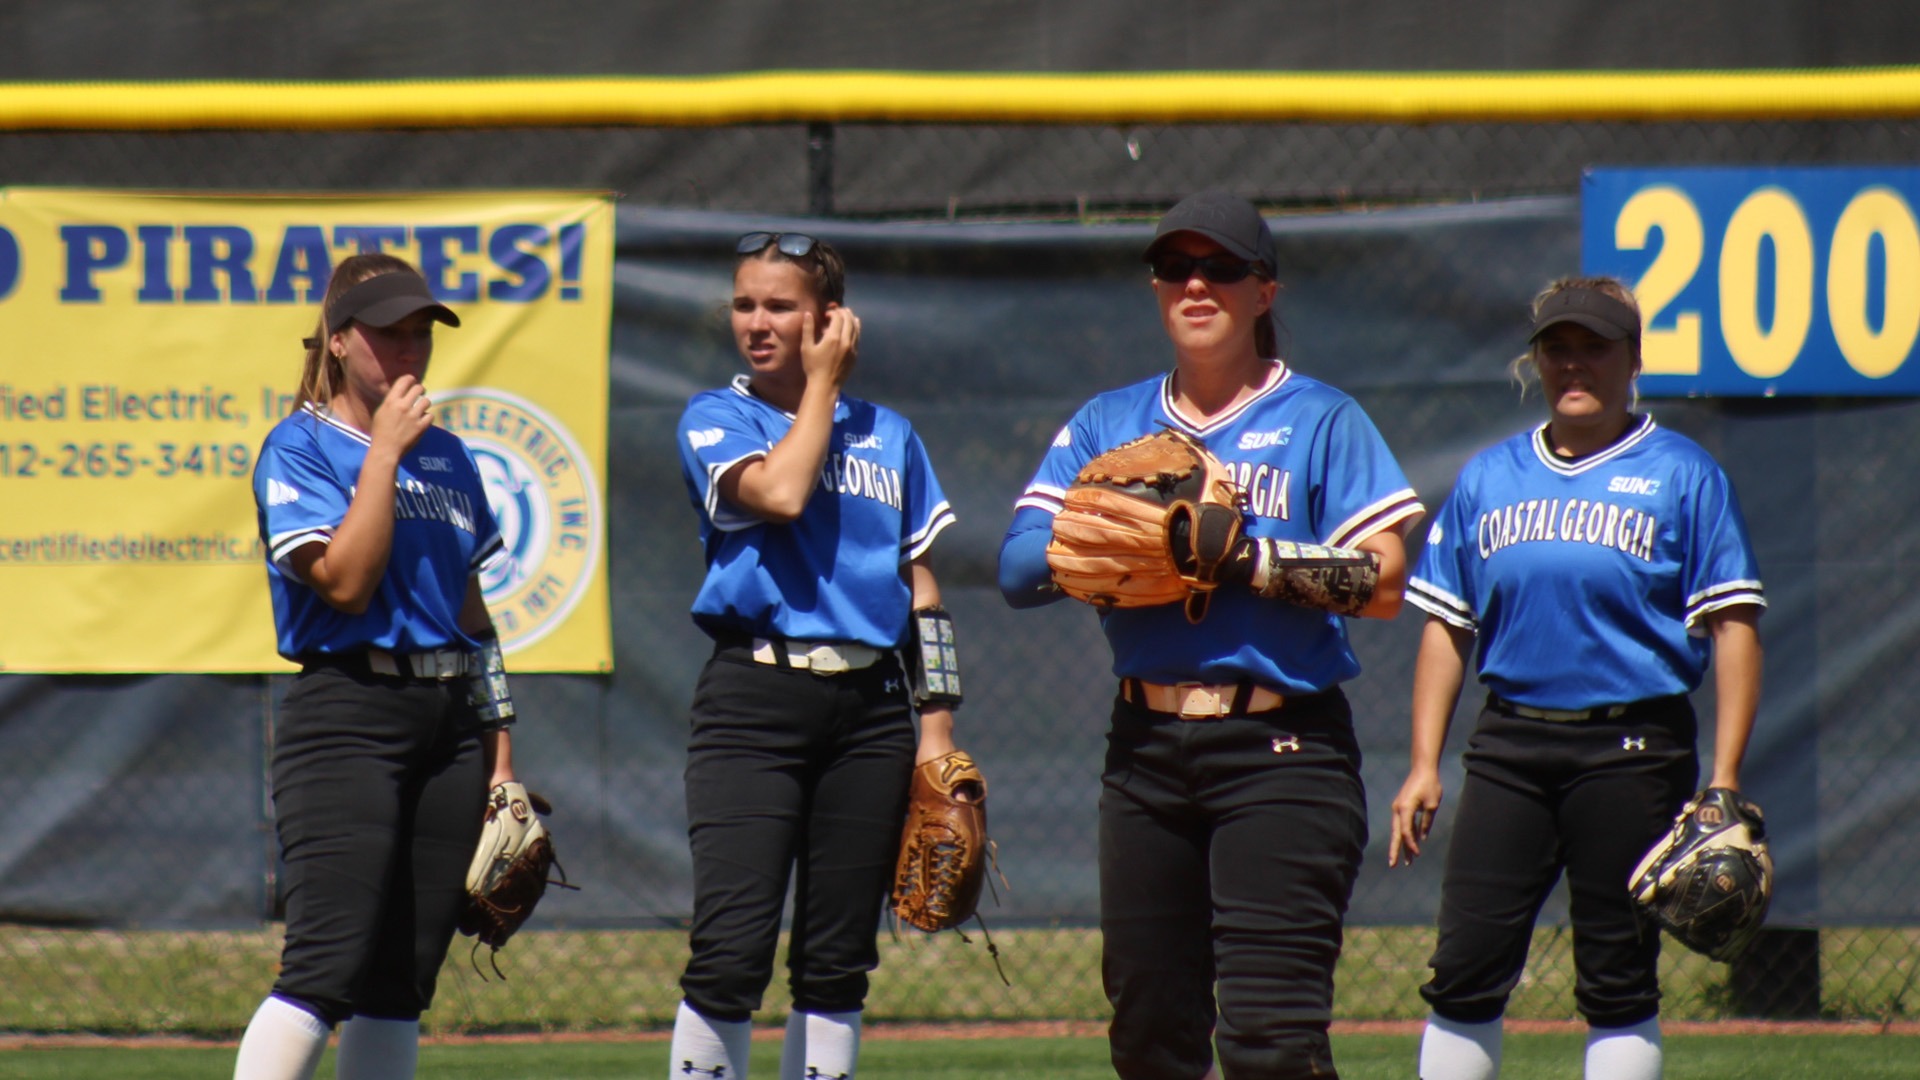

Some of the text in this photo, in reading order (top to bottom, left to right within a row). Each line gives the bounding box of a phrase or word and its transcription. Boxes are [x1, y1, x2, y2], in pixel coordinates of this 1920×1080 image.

[58, 221, 586, 304] PIRATES!
[1614, 184, 1920, 378] 200
[82, 385, 249, 428] Electric,
[0, 442, 251, 478] 12-265-3419
[1478, 498, 1656, 563] COASTAL GEORGIA
